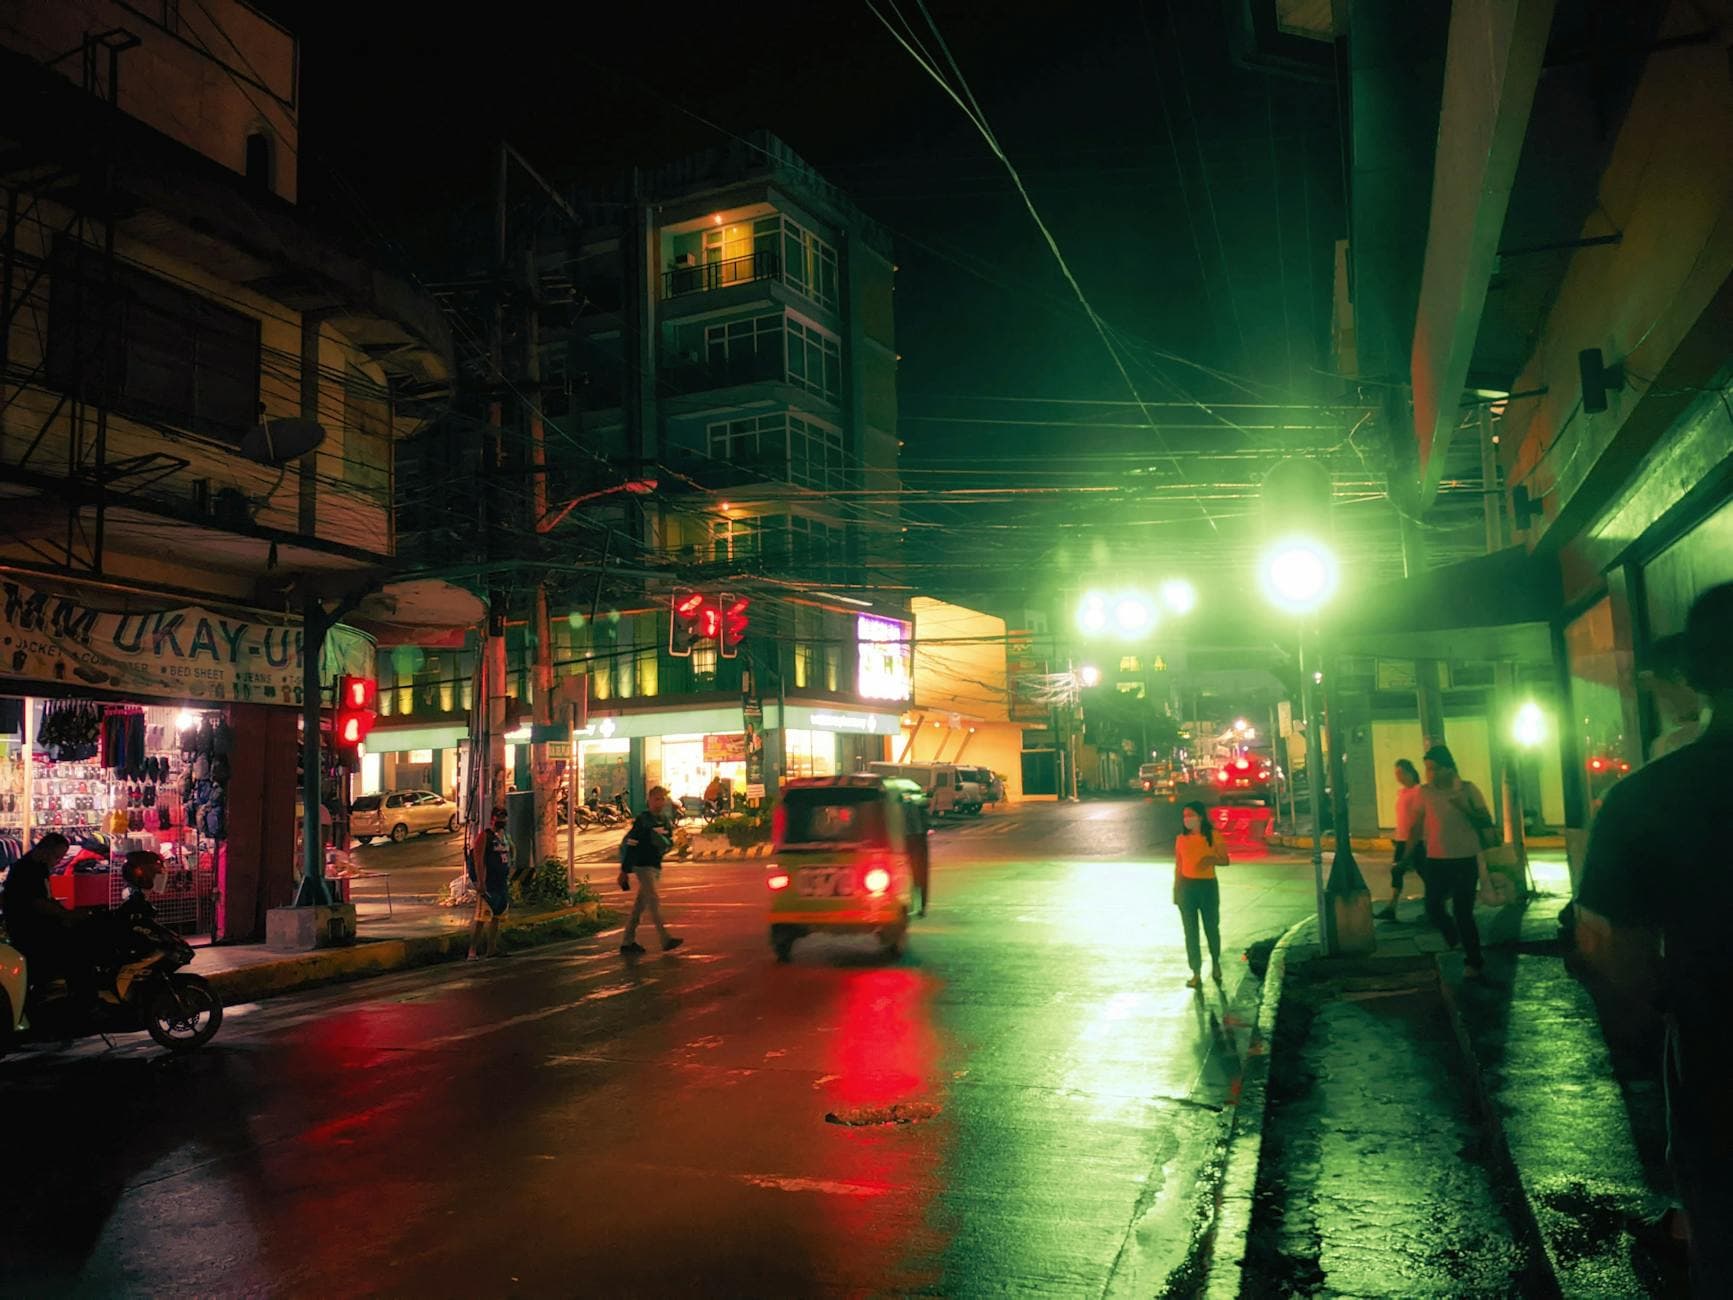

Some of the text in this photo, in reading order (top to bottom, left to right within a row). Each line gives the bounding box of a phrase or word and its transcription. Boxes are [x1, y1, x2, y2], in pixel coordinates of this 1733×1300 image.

[170, 666, 225, 680] BED SHEET
[244, 672, 273, 684] JEANS
